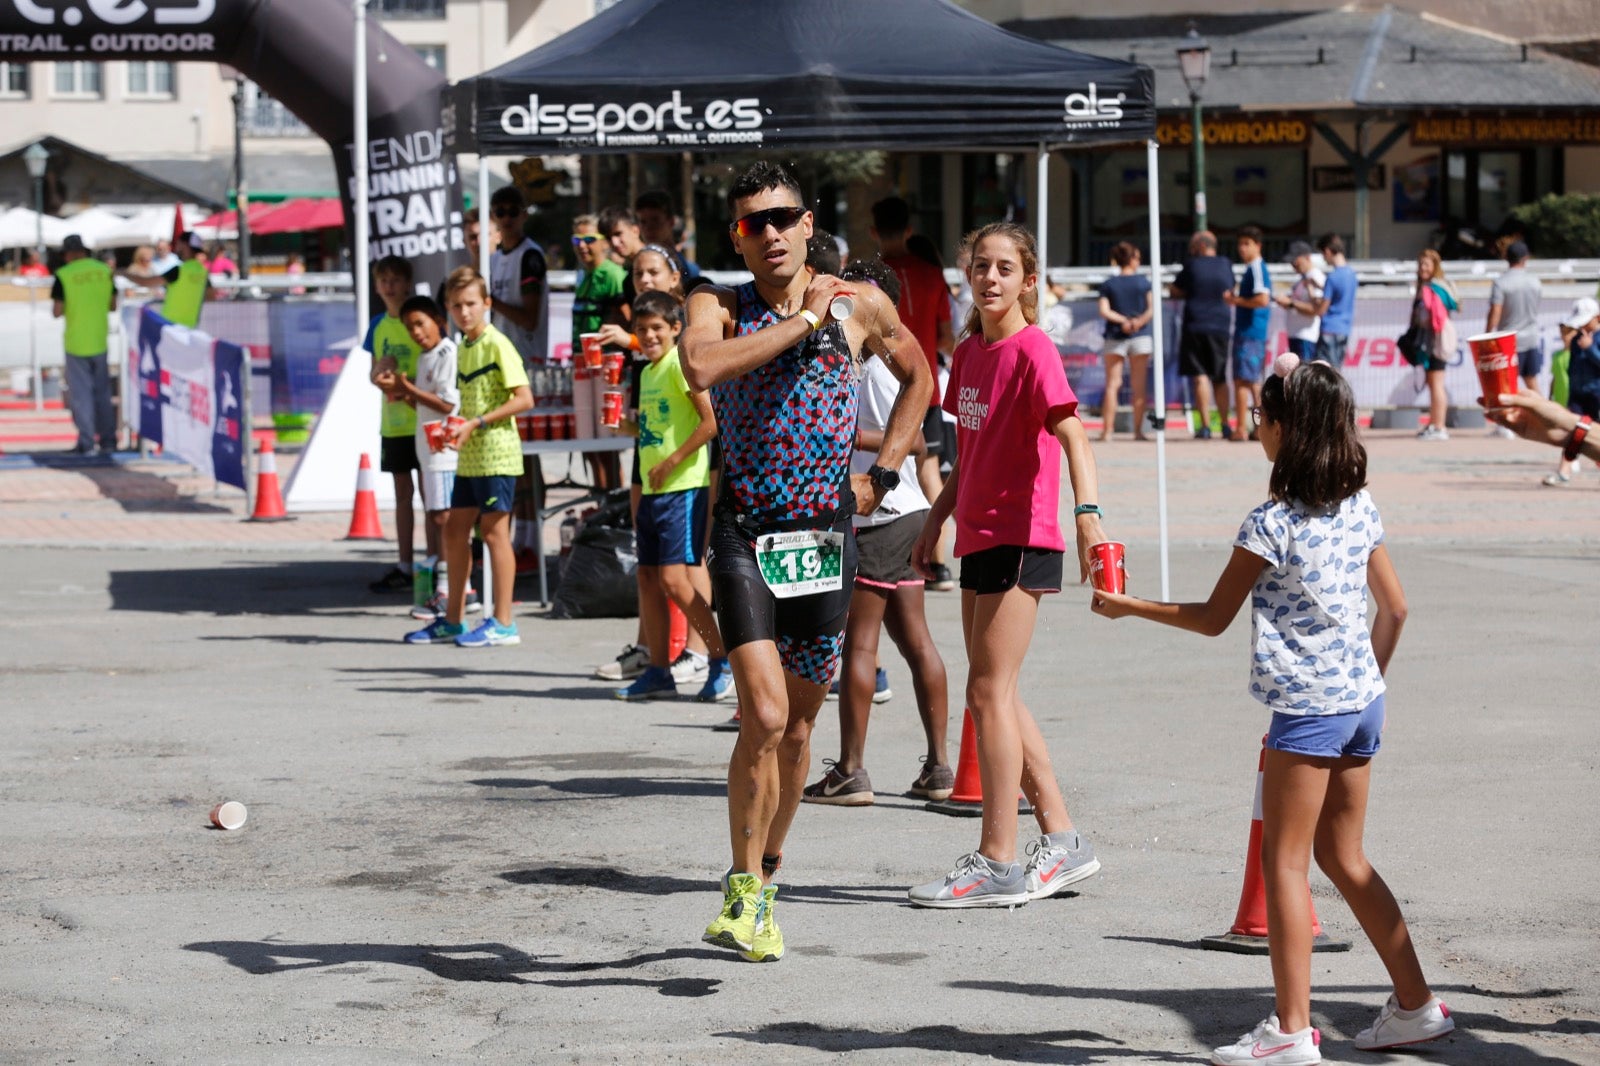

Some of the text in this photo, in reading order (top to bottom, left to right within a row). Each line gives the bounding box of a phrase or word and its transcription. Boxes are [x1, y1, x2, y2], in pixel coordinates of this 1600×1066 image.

[91, 33, 215, 51] OUTDOOR
[500, 90, 763, 147] alssport.es
[606, 134, 659, 146] RUNNING
[667, 133, 699, 144] TRAIL
[708, 131, 763, 143] OUTDOOR
[780, 549, 822, 581] 19
